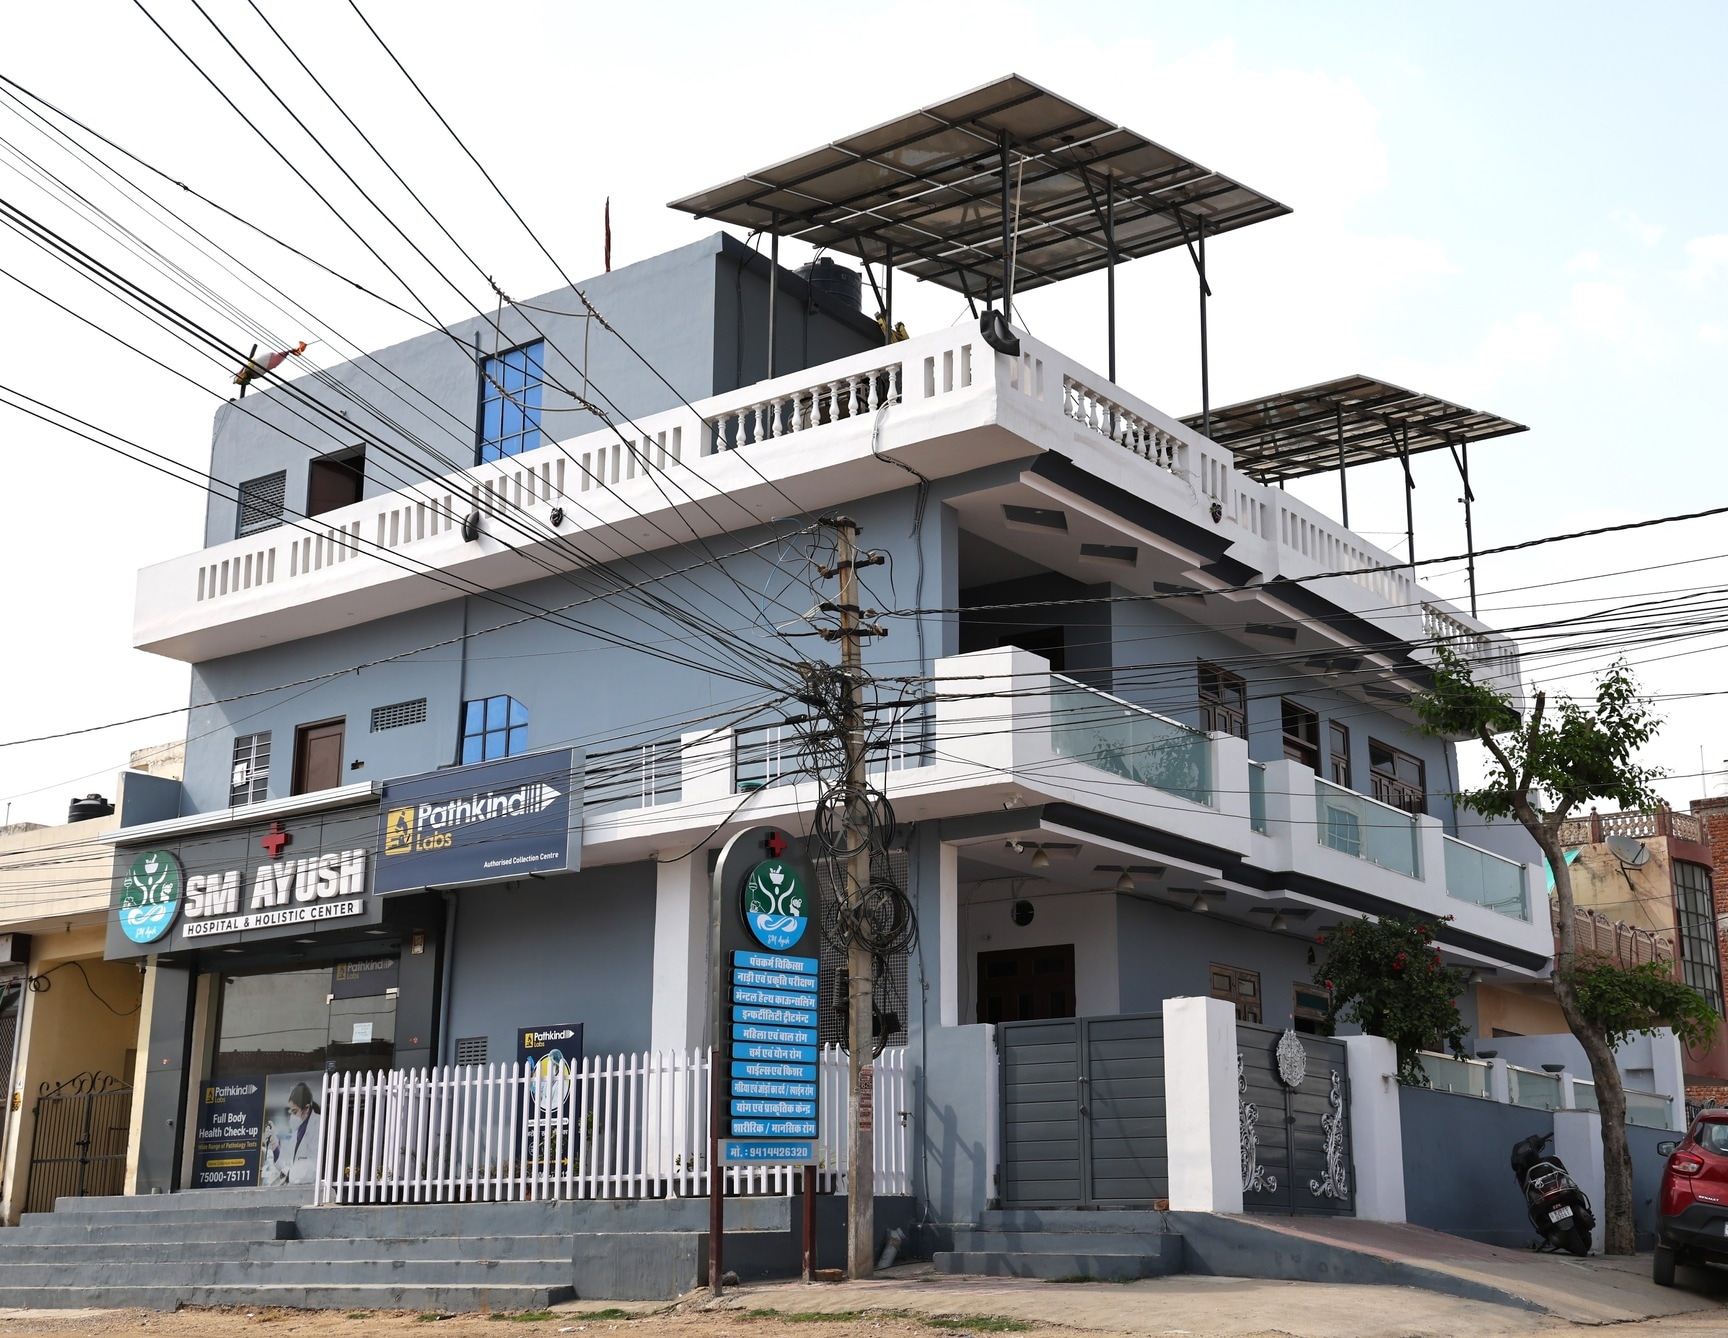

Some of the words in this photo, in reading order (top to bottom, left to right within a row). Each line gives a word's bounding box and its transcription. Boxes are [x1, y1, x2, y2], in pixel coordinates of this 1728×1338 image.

[417, 786, 526, 831] Pathkind
[416, 831, 452, 852] Labs
[484, 857, 512, 868] Authorised
[513, 854, 539, 864] Collection
[540, 852, 559, 862] Centre
[184, 870, 241, 918] SM
[251, 848, 367, 909] AYUSH
[188, 919, 239, 935] HOSPITAL
[244, 917, 250, 927] &
[255, 910, 305, 926] HOLISTIC
[311, 902, 354, 918] CENTER
[347, 960, 383, 972] Pathkind
[750, 955, 774, 968] पंचकर्म
[775, 958, 804, 971] चिकित्सा
[737, 971, 754, 985] नाड़ी
[755, 972, 766, 983] एवं
[767, 974, 788, 988] प्रकृति
[788, 976, 815, 988] परीक्षण
[736, 989, 757, 1002] मेन्टल
[534, 1030, 566, 1041] Pathkind
[743, 1027, 767, 1040] महिला
[767, 1029, 779, 1040] एवं
[780, 1032, 794, 1041] बाल
[795, 1031, 808, 1042] रोग
[749, 1046, 761, 1057] चर्म
[762, 1047, 774, 1058] एवं
[789, 1048, 802, 1059] रोग
[783, 1065, 803, 1077] फिशर
[215, 1085, 248, 1097] Pathkind
[750, 1082, 758, 1093] एवं
[770, 1085, 778, 1094] का
[805, 1084, 814, 1095] रोग
[736, 1100, 751, 1112] योग
[752, 1101, 764, 1112] एवं
[764, 1102, 794, 1116] प्राकृतिक
[213, 1113, 226, 1124] Full
[228, 1112, 246, 1124] Body
[199, 1128, 222, 1138] Health
[223, 1126, 258, 1137] Check-up
[733, 1122, 764, 1133] शारीरिक
[771, 1122, 801, 1133] मानसिक
[802, 1122, 815, 1133] रोग
[749, 1147, 808, 1157] 9414426320
[200, 1170, 250, 1182] 75000-75111
